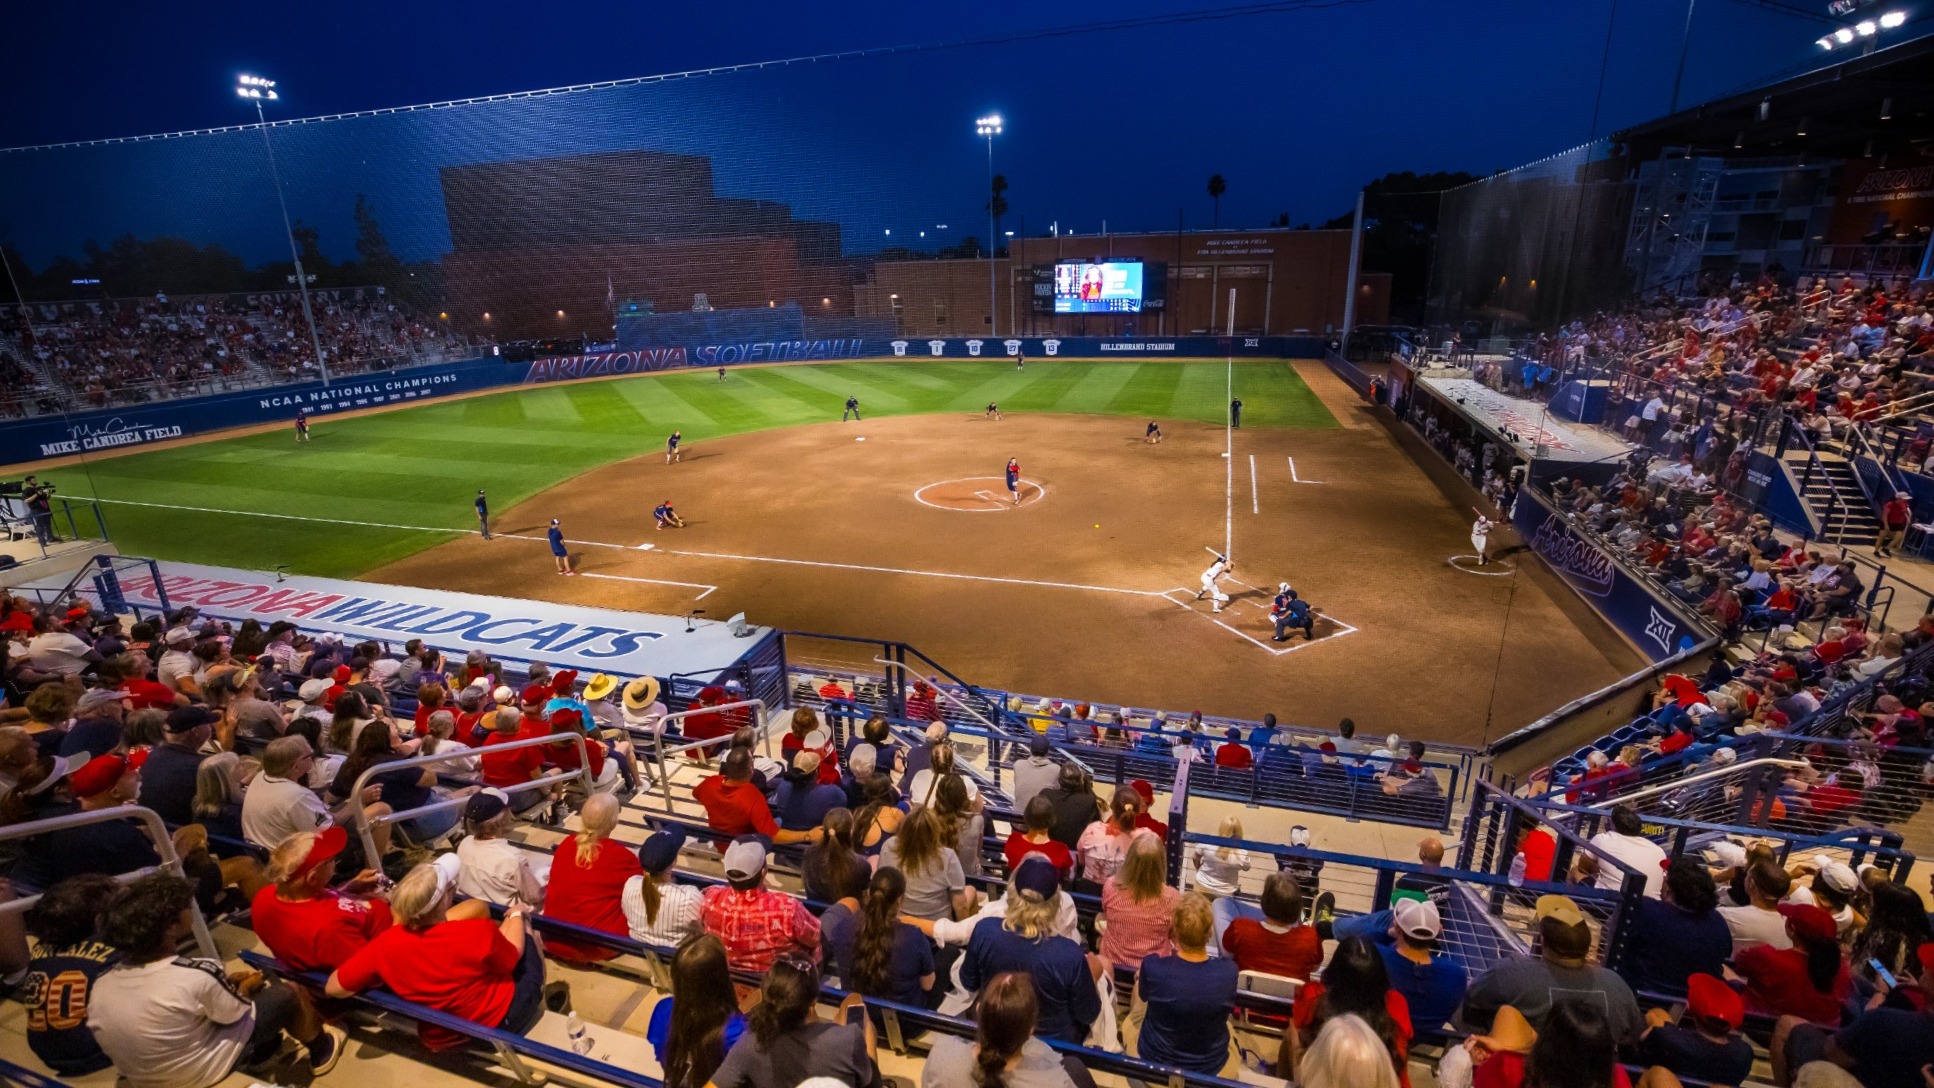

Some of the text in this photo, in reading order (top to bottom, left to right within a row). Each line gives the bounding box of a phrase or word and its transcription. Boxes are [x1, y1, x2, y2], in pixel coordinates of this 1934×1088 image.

[1867, 193, 1895, 201] NATIONAL
[523, 339, 862, 383] ARIZONA SOFTBALL
[1100, 343, 1175, 351] HILLENBRAND STADIUM
[260, 374, 457, 408] NCAA NATIONAL CHAMPIONS
[40, 425, 182, 456] MIKE CANDREA FIELD
[1531, 513, 1615, 597] Arizona
[120, 573, 667, 659] ARIZONA WILDCATS
